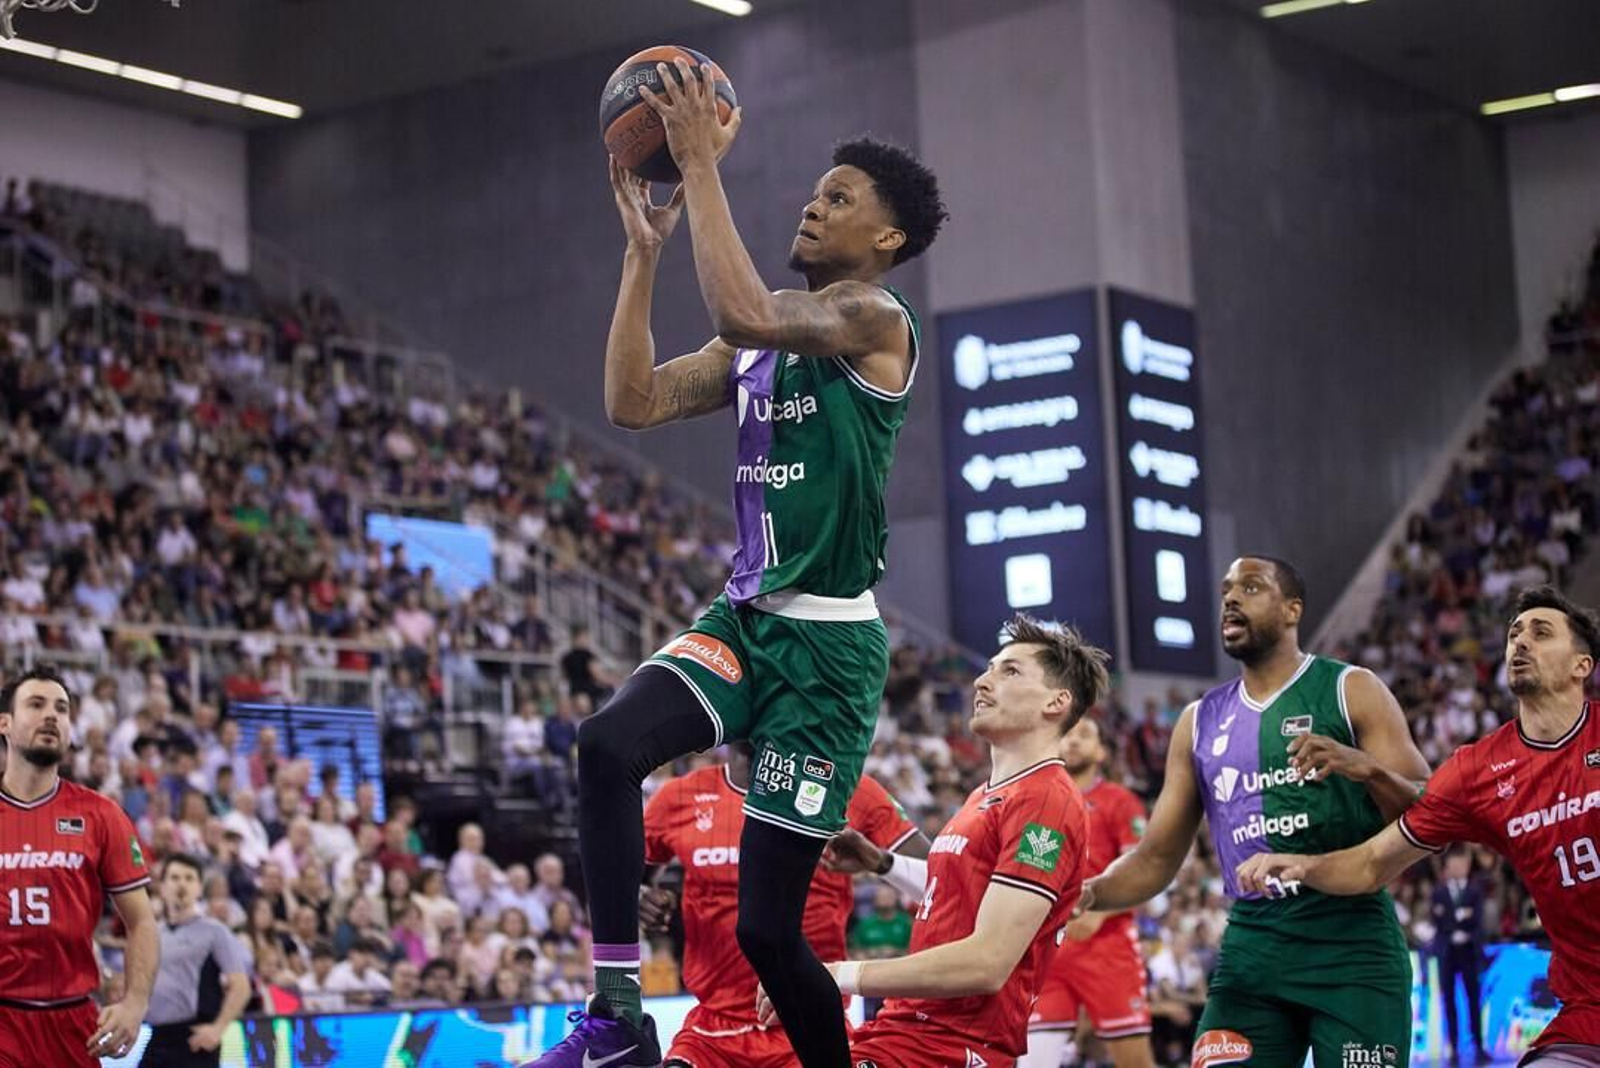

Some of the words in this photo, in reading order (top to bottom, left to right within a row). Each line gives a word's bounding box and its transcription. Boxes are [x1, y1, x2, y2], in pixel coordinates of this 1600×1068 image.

[754, 393, 817, 424] Uicaja
[1232, 813, 1310, 845] málaga
[1554, 837, 1600, 888] 19
[8, 887, 51, 926] 15
